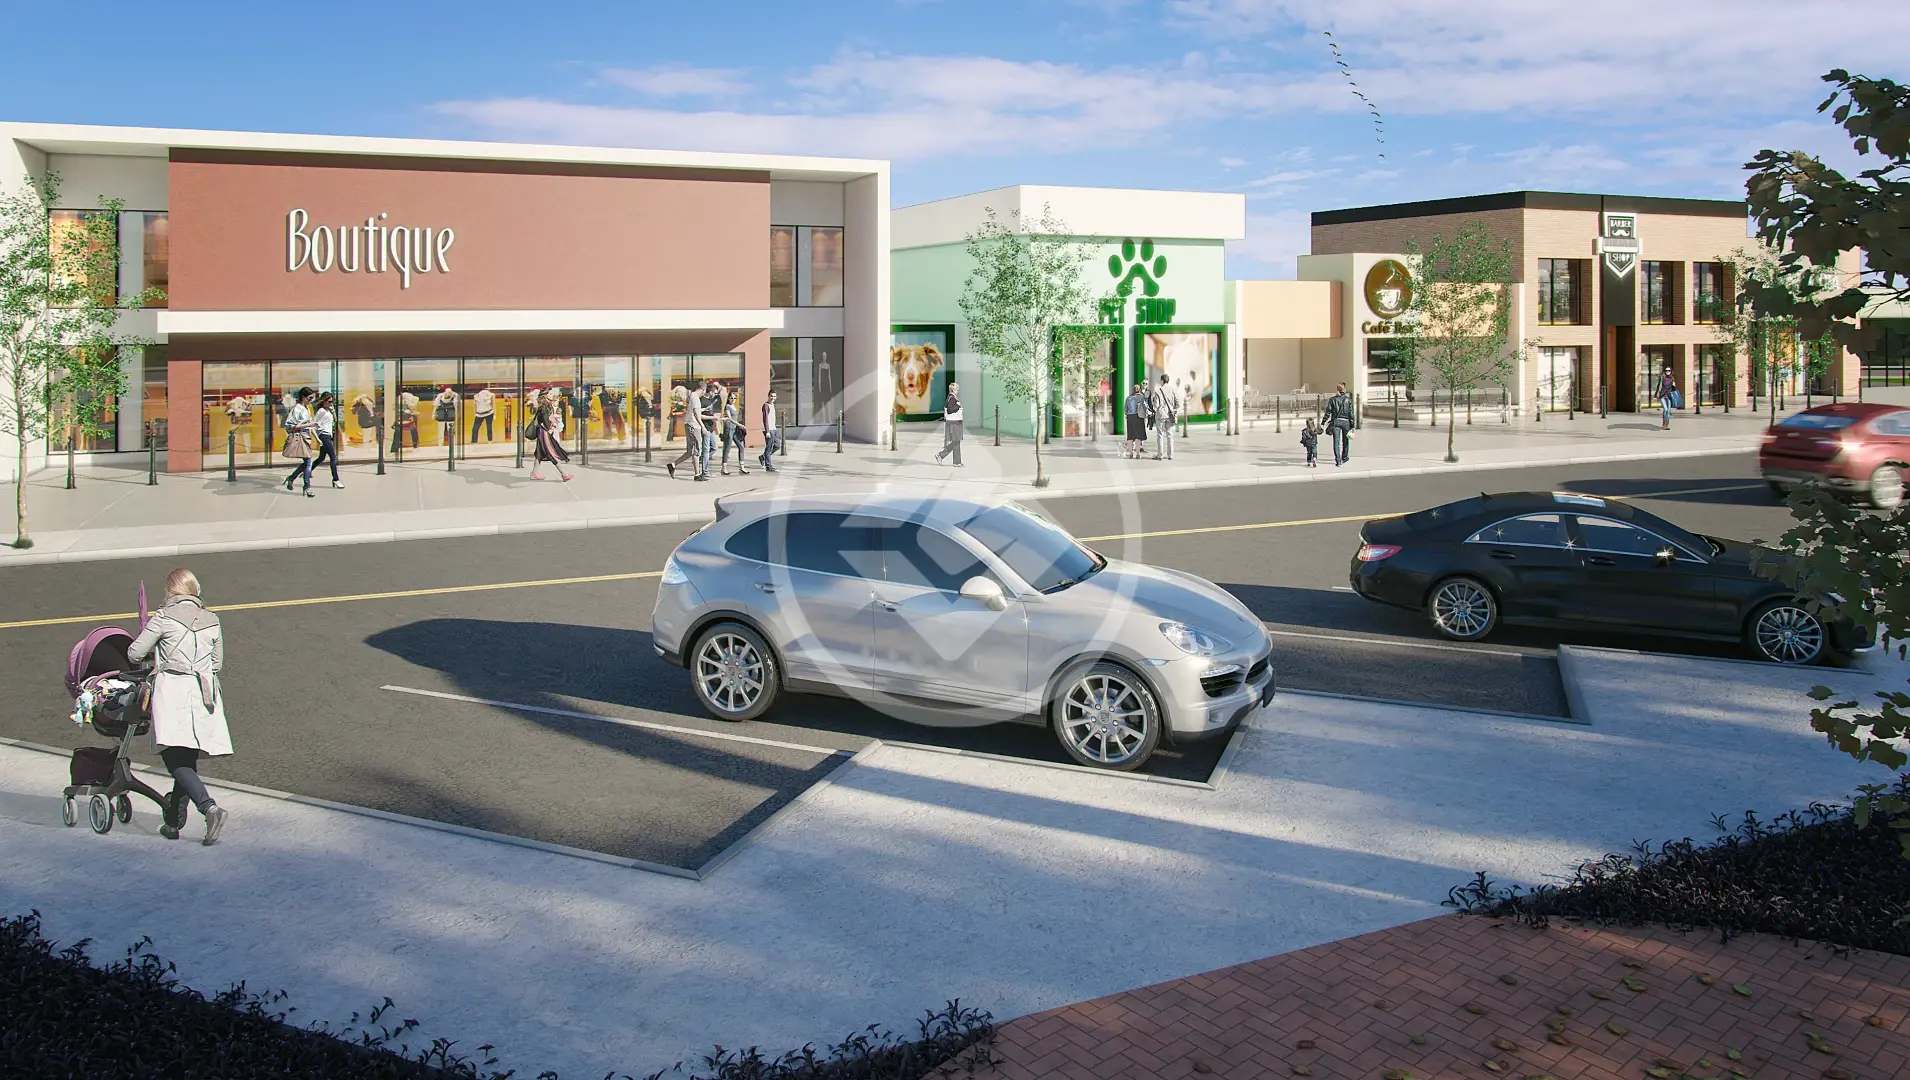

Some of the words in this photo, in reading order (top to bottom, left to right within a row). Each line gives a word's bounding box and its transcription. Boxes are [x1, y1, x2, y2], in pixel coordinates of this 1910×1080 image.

[1610, 219, 1632, 228] BARBER
[287, 208, 455, 289] Boutique
[1612, 253, 1630, 262] SHOP
[1135, 297, 1176, 324] SHOP
